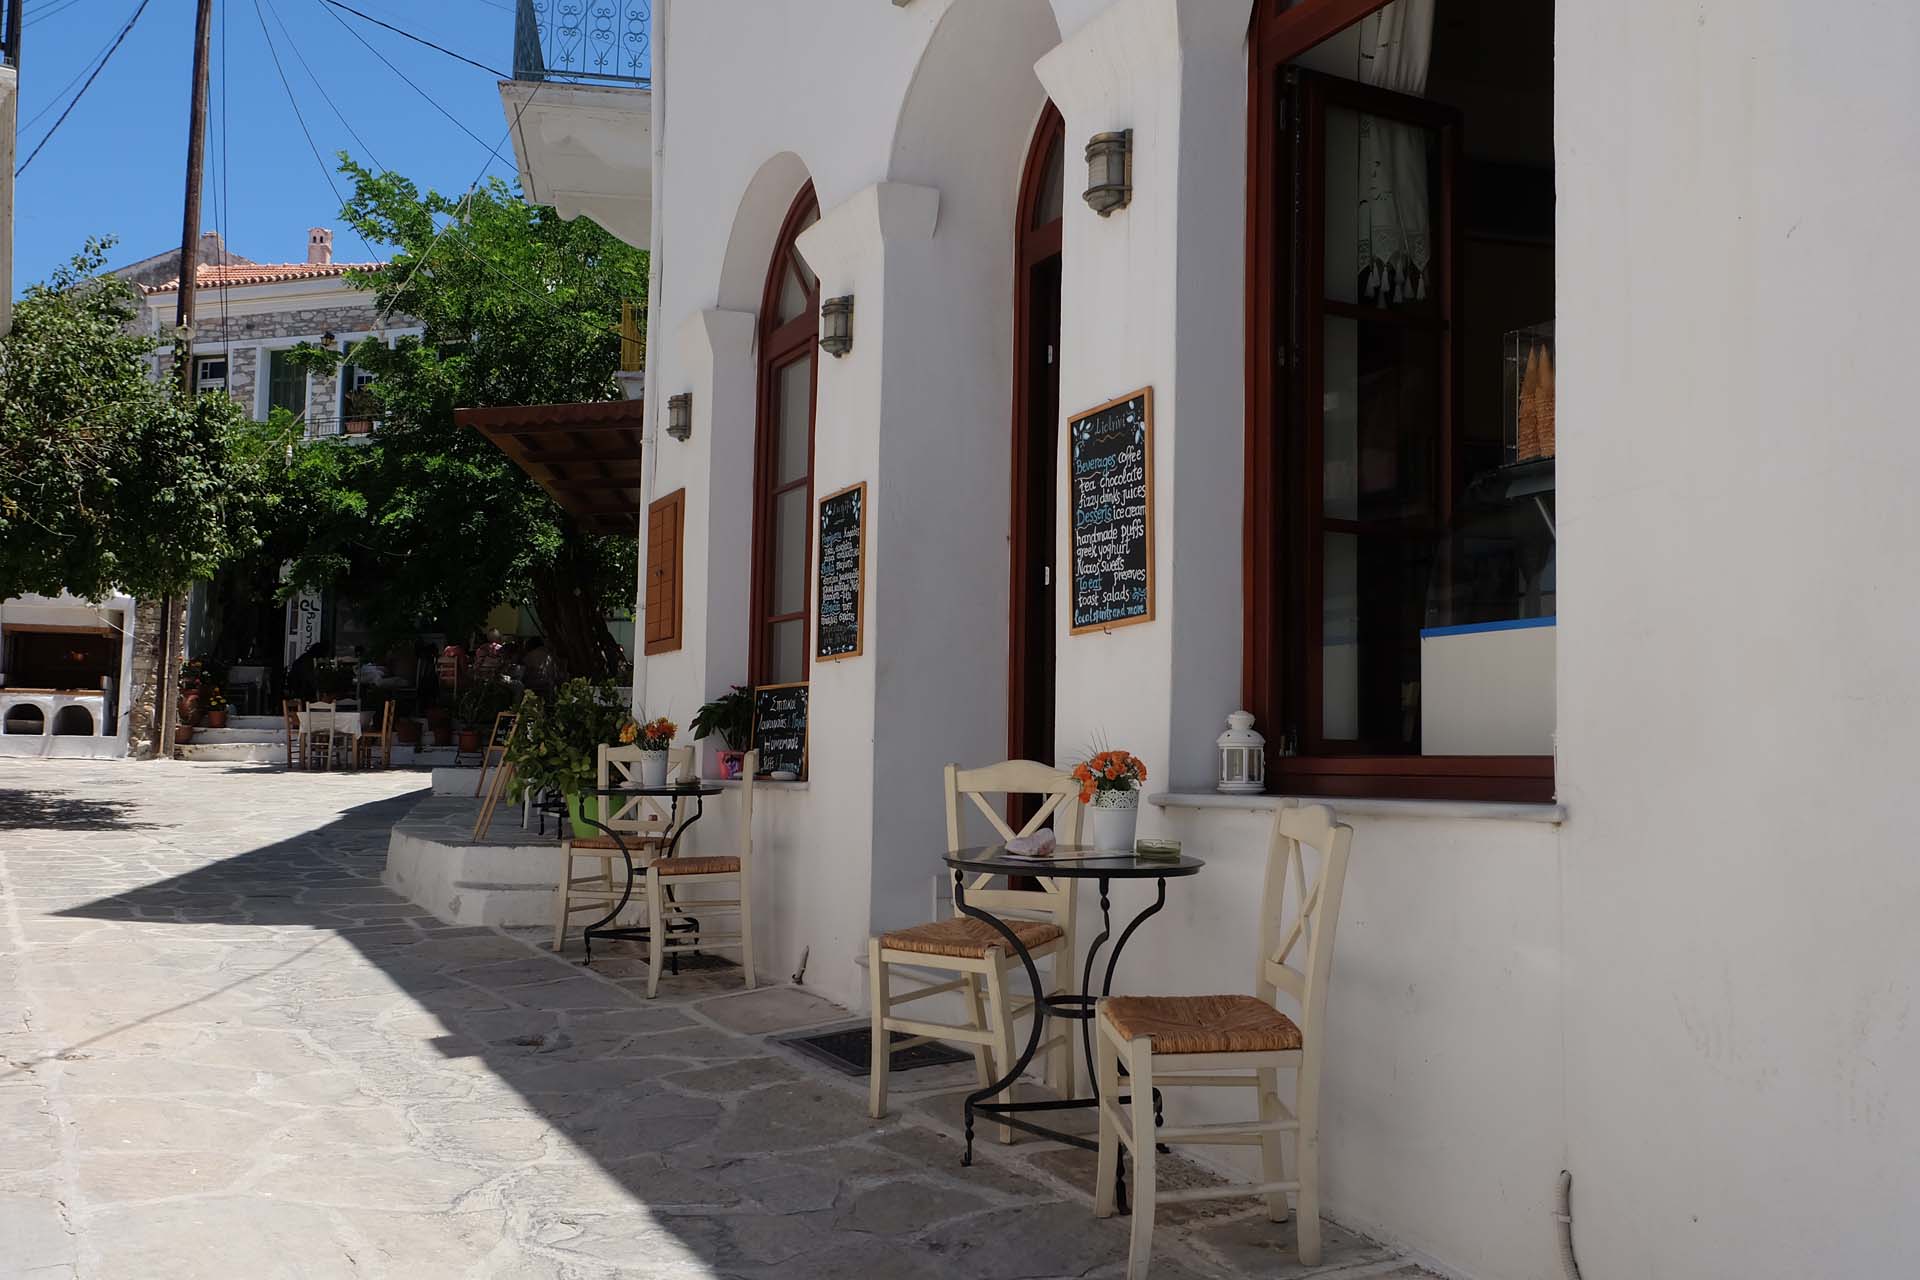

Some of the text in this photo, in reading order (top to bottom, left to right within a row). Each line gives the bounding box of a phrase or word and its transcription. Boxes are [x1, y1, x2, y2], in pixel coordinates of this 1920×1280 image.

[1076, 445, 1141, 475] Beverages coffee
[1079, 466, 1142, 493] tea chocolate
[1079, 484, 1146, 510] fizzy drinks juices
[1076, 504, 1146, 526] Desserts ice cream
[1076, 519, 1144, 546] handmade puffs
[1098, 538, 1130, 562] yoghurt
[1101, 555, 1125, 572] sweets
[1076, 575, 1102, 590] To eat
[1113, 568, 1145, 586] preserves
[1078, 584, 1130, 607] toast salads
[1127, 605, 1144, 615] more
